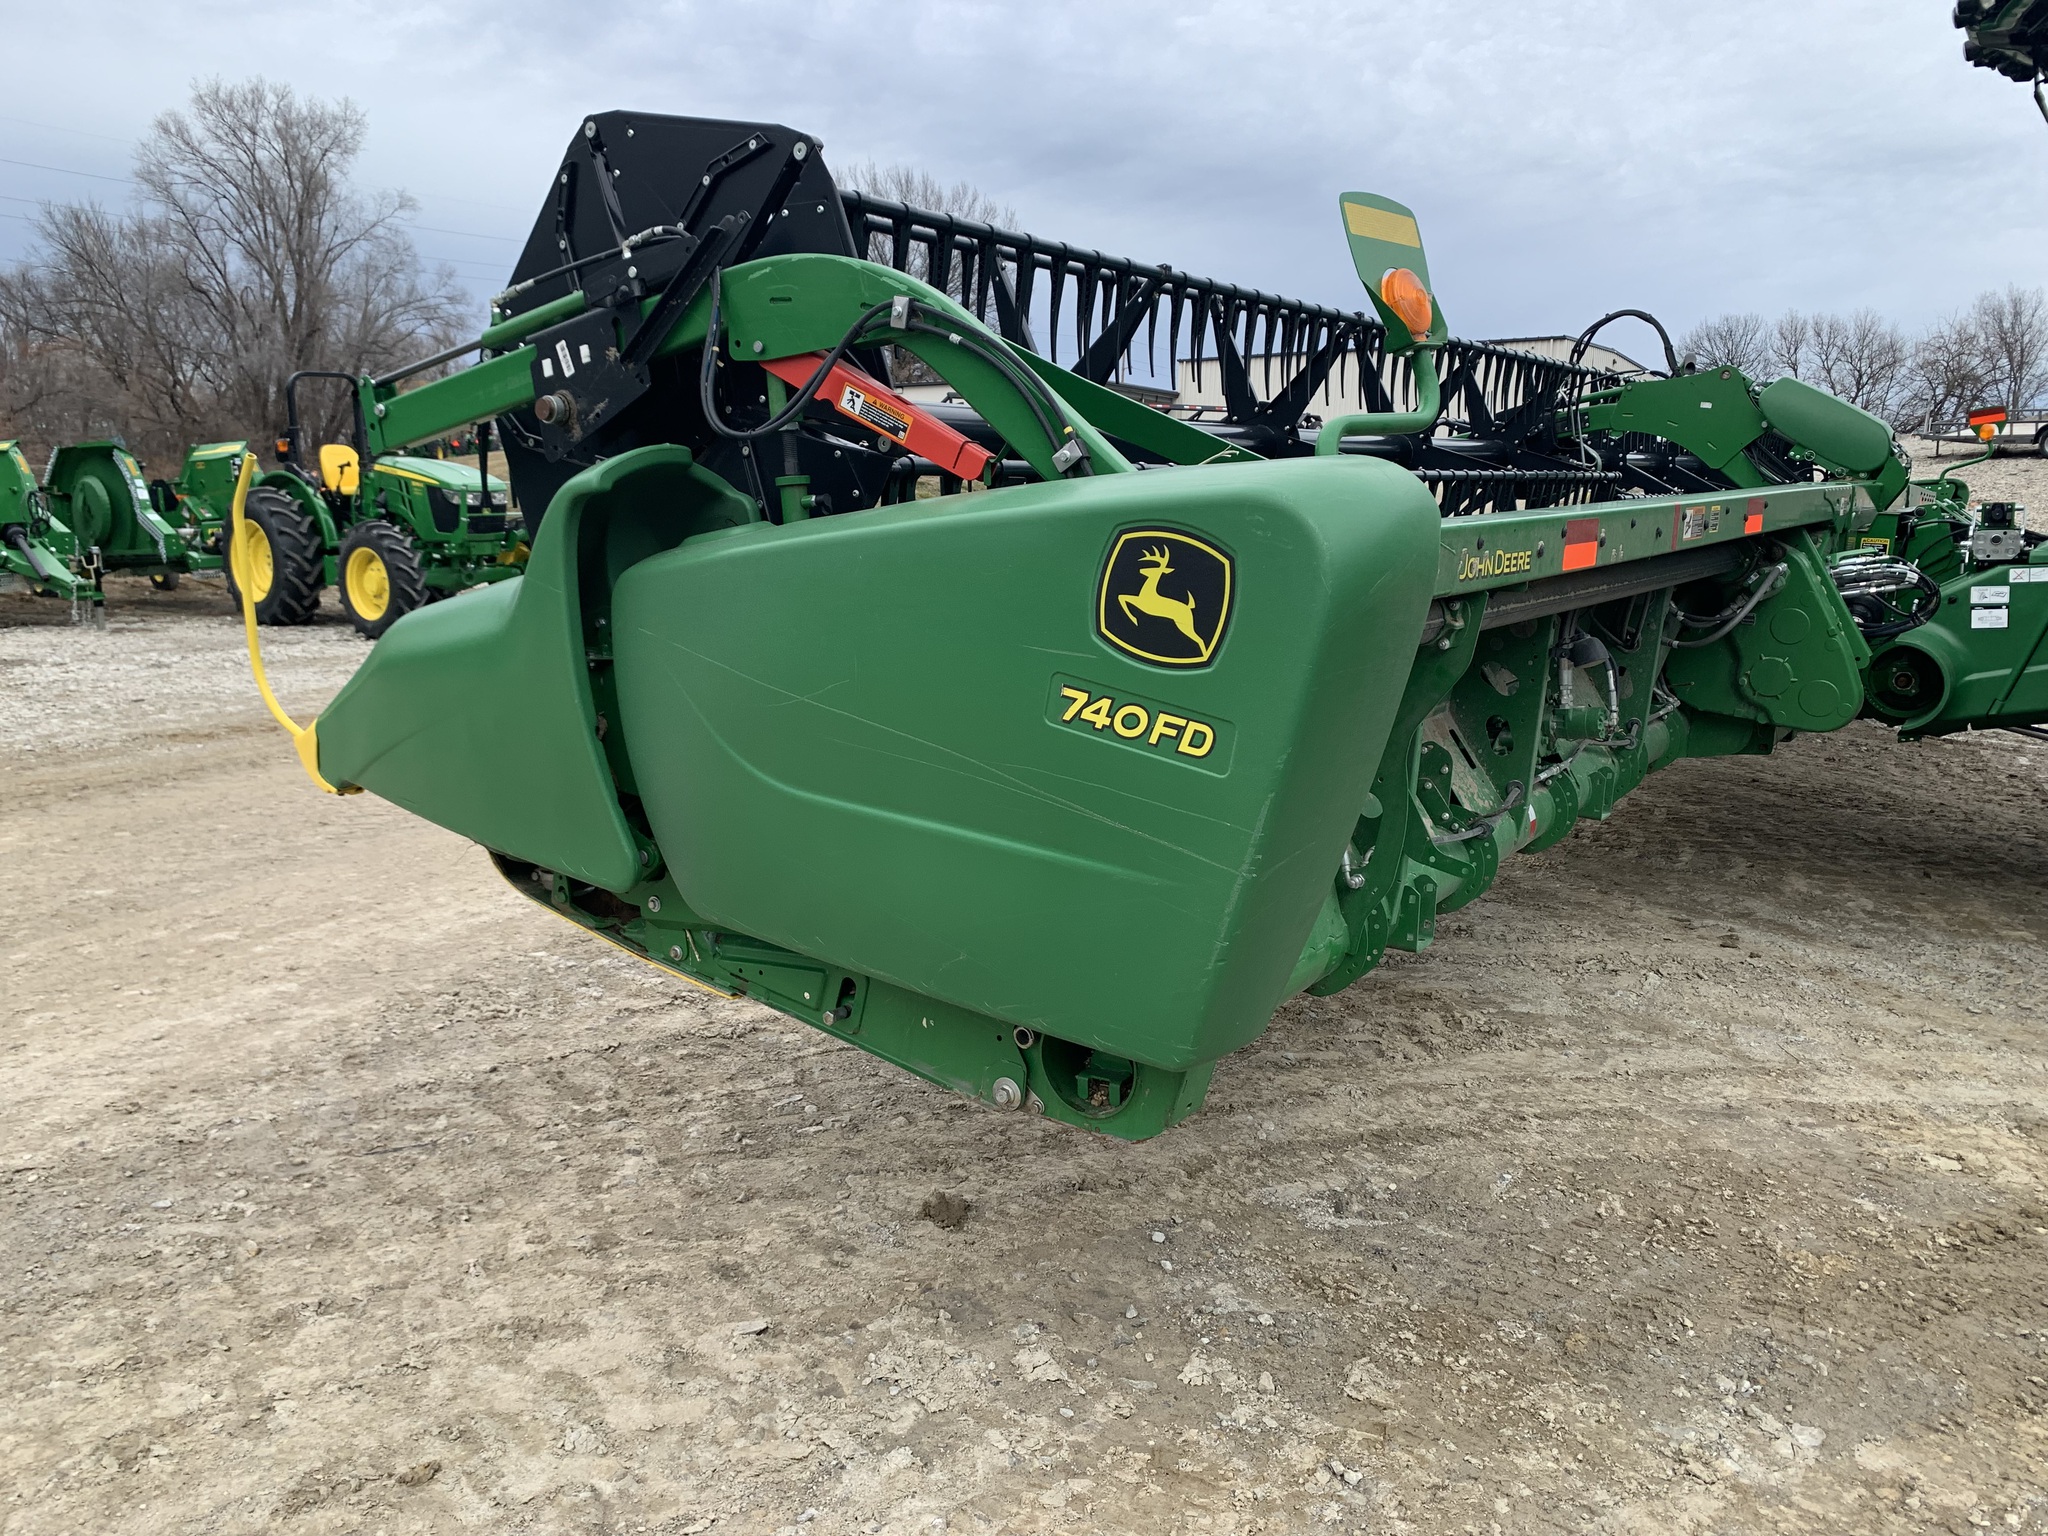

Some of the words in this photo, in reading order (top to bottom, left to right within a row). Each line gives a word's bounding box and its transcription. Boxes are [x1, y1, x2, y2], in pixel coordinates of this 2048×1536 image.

[879, 401, 905, 420] WARNING
[1459, 553, 1494, 581] JOHN
[1494, 549, 1532, 576] DEERE
[1061, 685, 1215, 758] 740FD
